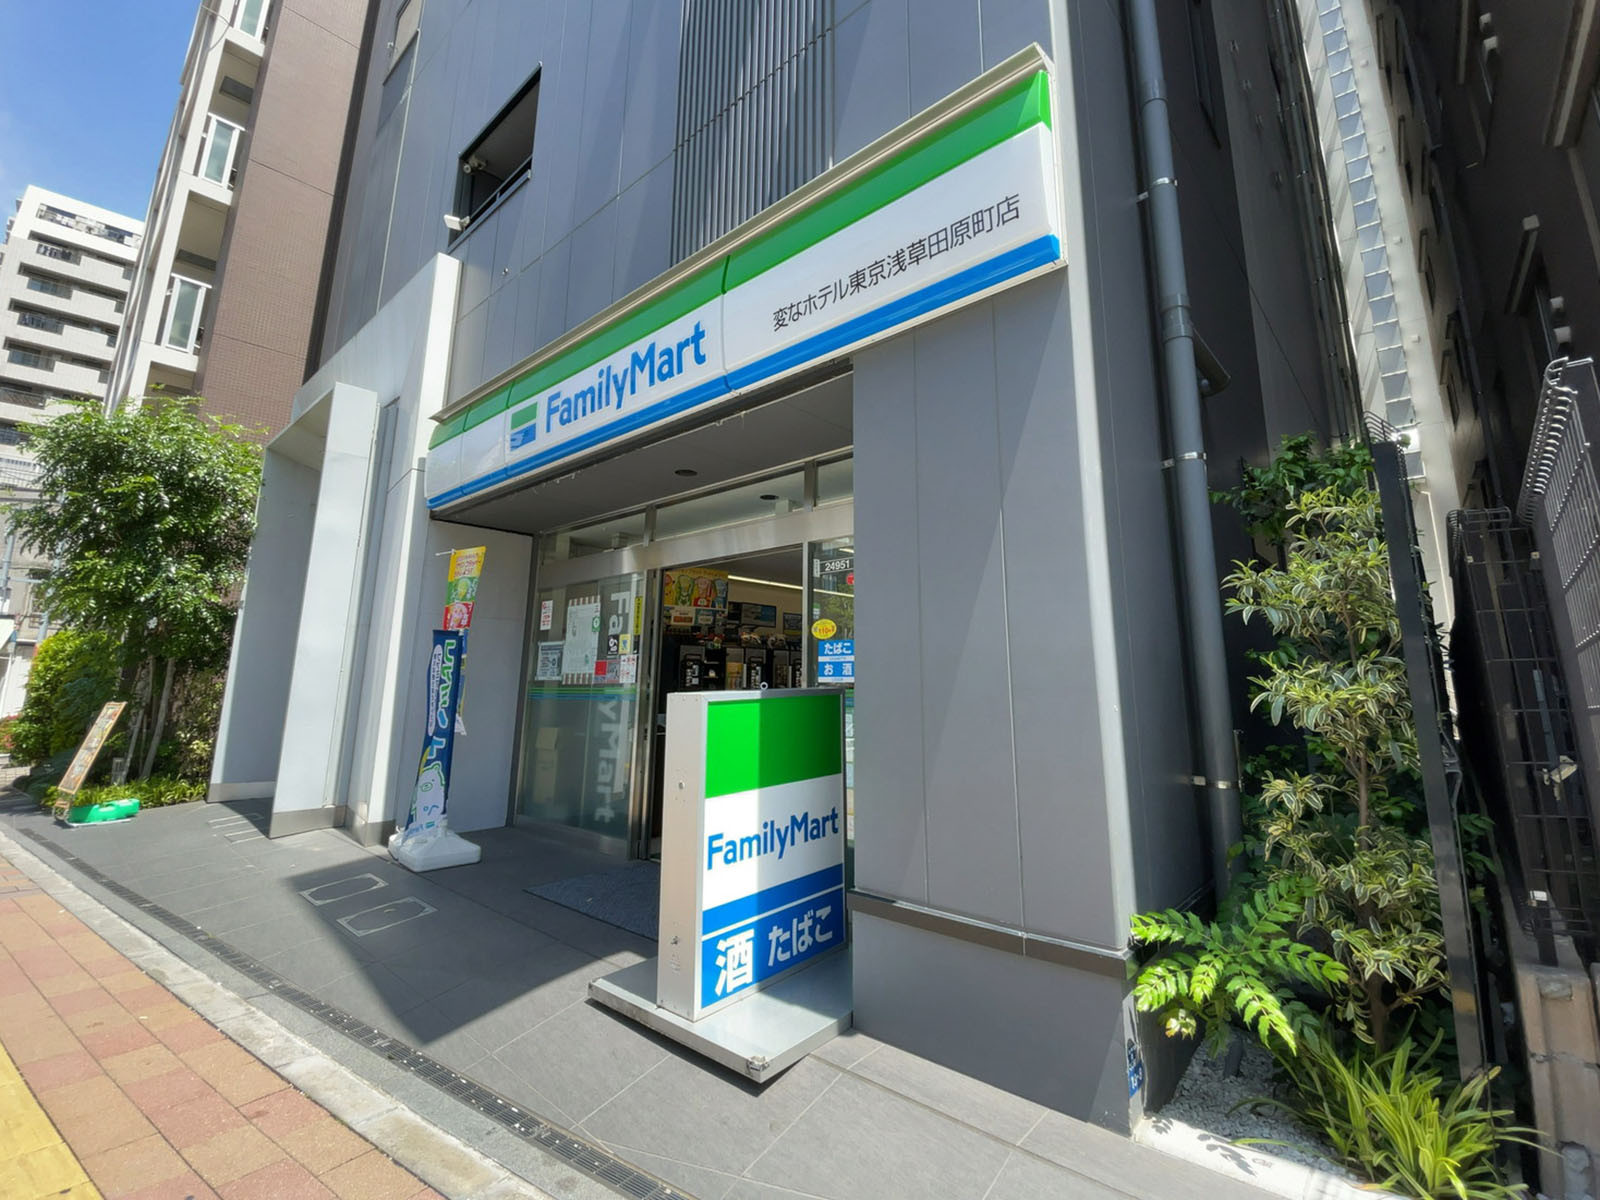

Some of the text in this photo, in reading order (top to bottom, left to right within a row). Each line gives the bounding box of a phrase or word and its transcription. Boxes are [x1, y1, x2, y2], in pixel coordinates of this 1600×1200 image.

[772, 193, 1020, 332] 変なホテル東京浅草田原町店
[546, 320, 706, 433] FamilyMart
[824, 560, 850, 571] 24951
[824, 642, 852, 655] たばこ
[706, 807, 839, 871] FamilyMart
[714, 905, 833, 997] 酒 たばこ
